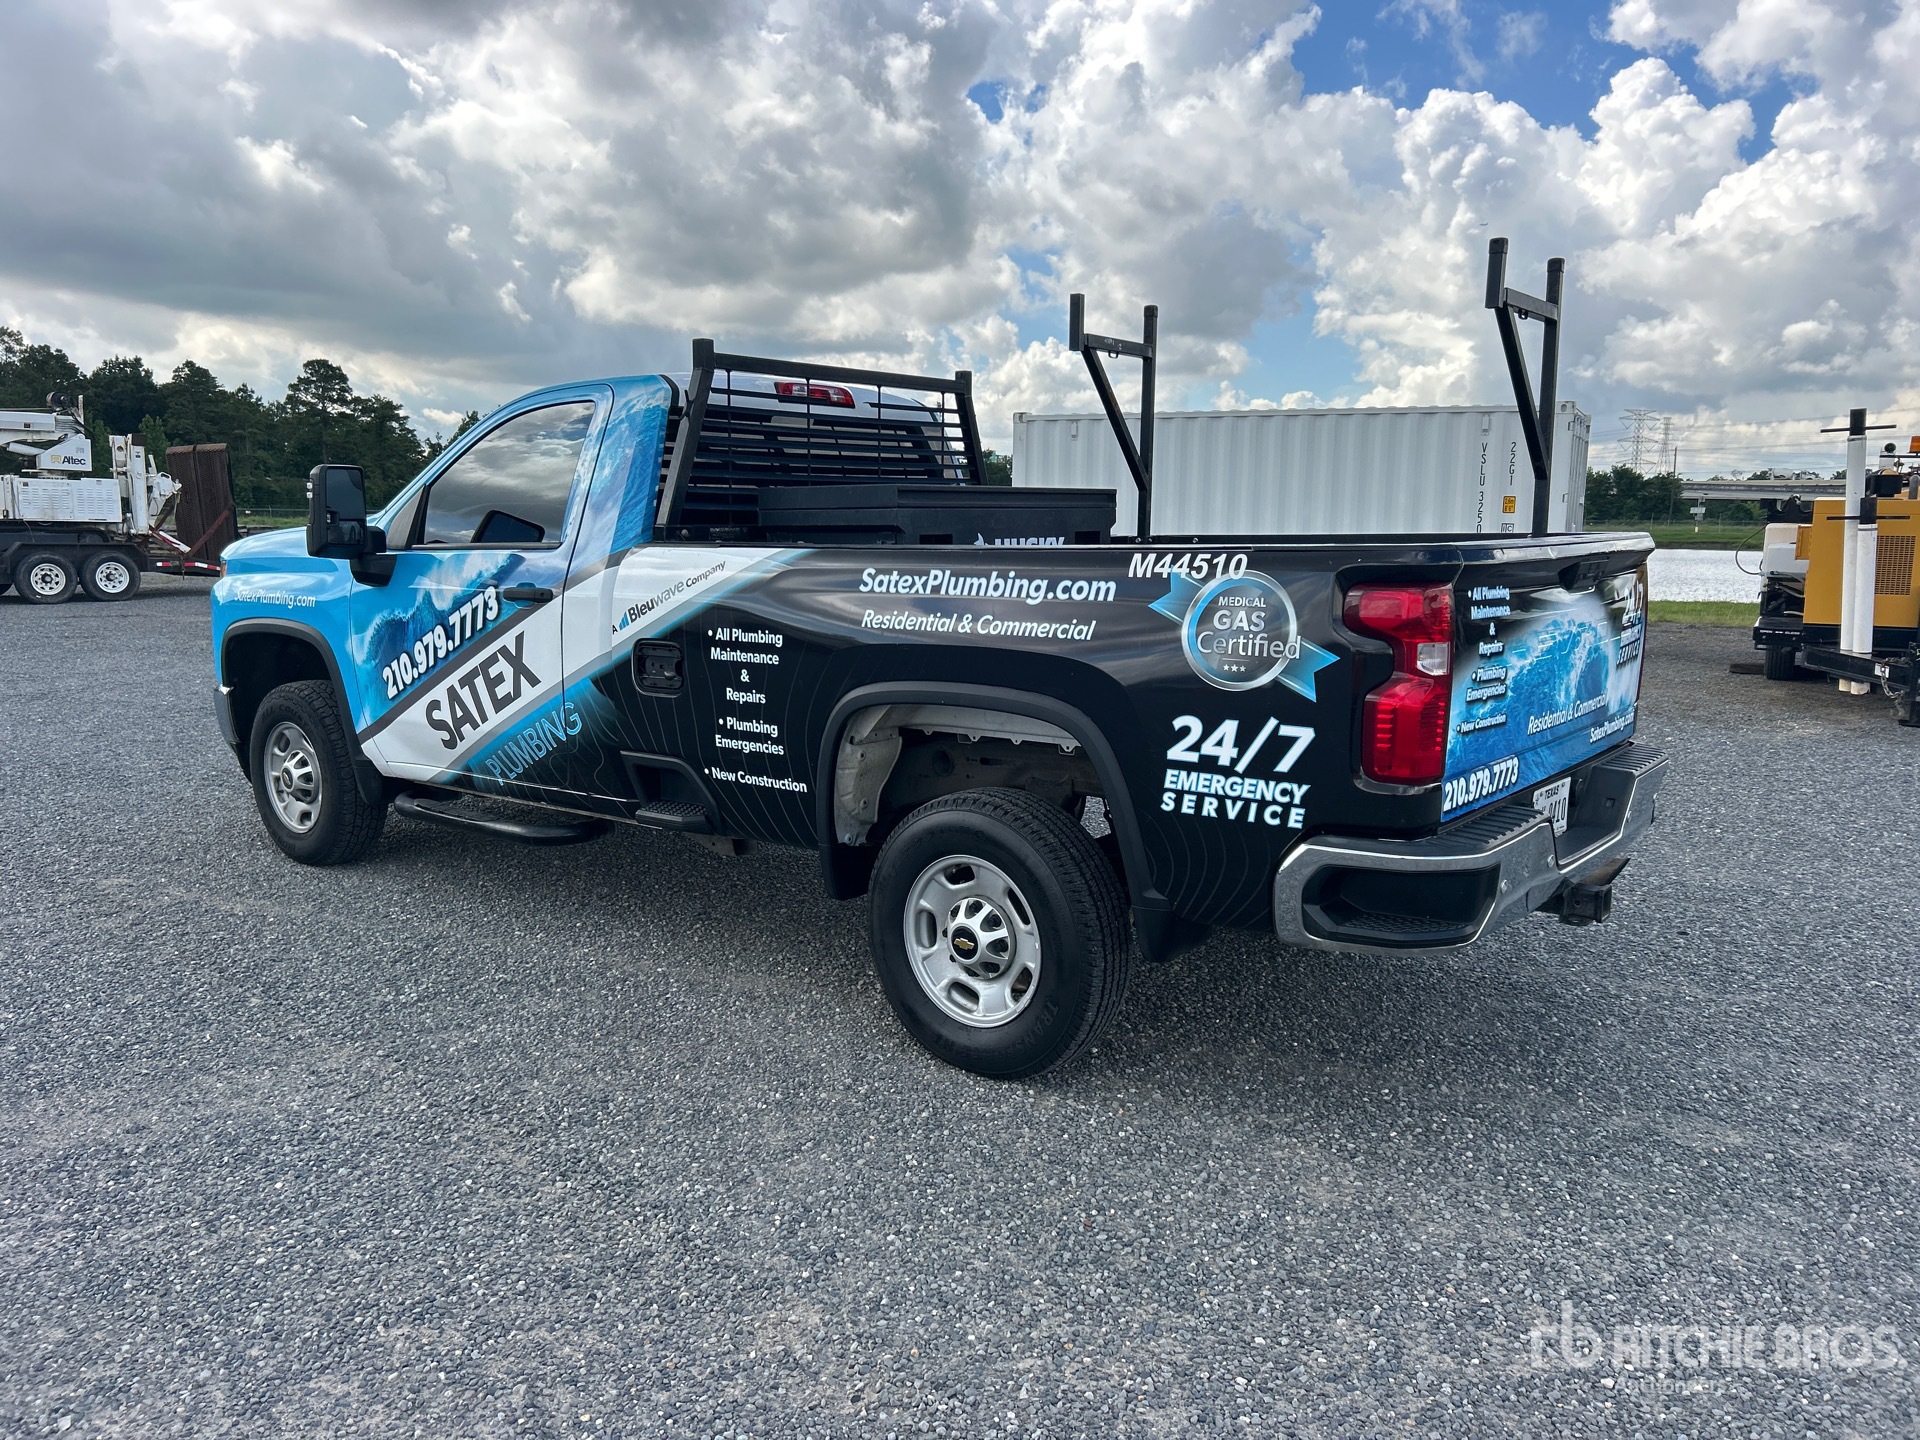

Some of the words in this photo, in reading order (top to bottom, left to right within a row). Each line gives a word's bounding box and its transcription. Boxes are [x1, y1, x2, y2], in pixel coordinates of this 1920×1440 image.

[62, 456, 86, 465] Altec
[1479, 442, 1488, 486] VSLU
[1509, 441, 1517, 486] 22G1
[1127, 553, 1248, 580] M44510
[234, 588, 316, 609] SatexPlumbing.com
[611, 625, 618, 635] A
[627, 580, 685, 624] Bleuwave
[685, 561, 726, 588] Company
[858, 568, 1117, 606] SatexPlumbing.com
[1473, 587, 1482, 601] All
[1482, 585, 1510, 601] Plumbing
[1218, 596, 1267, 608] MEDICAL
[1471, 605, 1510, 620] Maintenance
[861, 609, 957, 633] Residential
[958, 613, 972, 633] &
[975, 614, 1097, 642] Commercial
[1212, 609, 1266, 631] GAS
[1489, 622, 1496, 636] &
[381, 585, 499, 700] 210.979.7773
[715, 628, 730, 641] All
[732, 629, 783, 647] Plumbing
[1196, 630, 1301, 660] Certified
[1479, 640, 1504, 656] Repairs
[710, 647, 780, 665] Maintenance
[740, 669, 750, 683] &
[1477, 666, 1506, 682] Plumbing
[425, 631, 542, 749] SATEX
[726, 687, 766, 704] Repairs
[1466, 683, 1506, 702] Emergencies
[726, 716, 778, 737] Plumbing
[1460, 720, 1475, 733] New
[1475, 713, 1507, 730] Construction
[1527, 708, 1568, 737] Residential
[1568, 704, 1574, 721] &
[1590, 712, 1635, 744] SatexPlumbing.com
[485, 701, 583, 787] PLUMBING
[715, 734, 784, 755] Emergencies
[1166, 715, 1316, 774] 24/7
[711, 767, 736, 782] New
[737, 770, 808, 793] Construction
[1163, 768, 1312, 805] EMERGENCY
[1443, 757, 1519, 812] 210.979.7773
[1160, 791, 1306, 829] SERVICE
